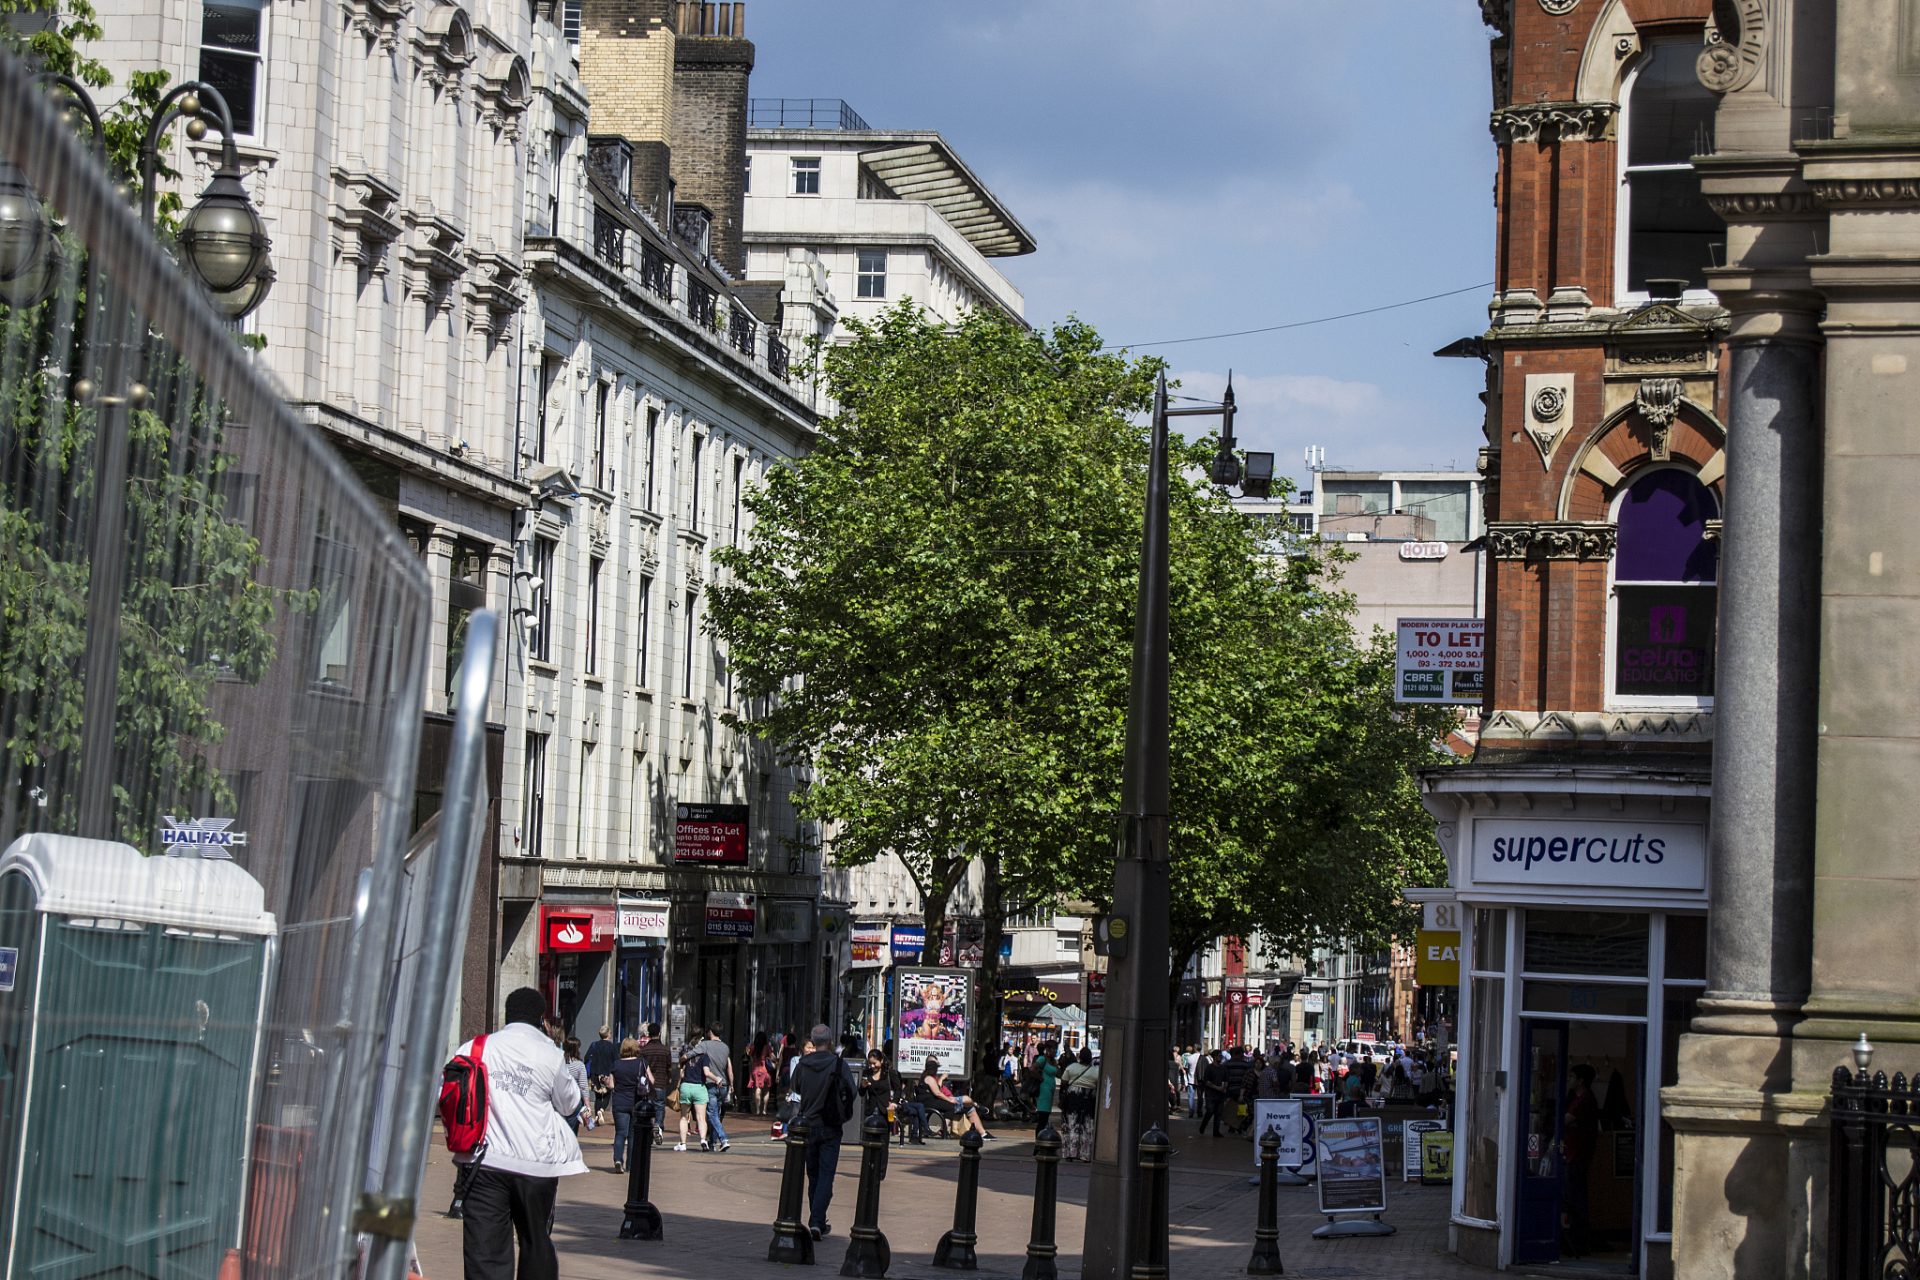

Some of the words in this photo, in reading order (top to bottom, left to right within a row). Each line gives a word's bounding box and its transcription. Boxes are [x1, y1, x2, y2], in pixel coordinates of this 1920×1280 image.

[1403, 544, 1446, 556] HOTEL
[1415, 631, 1441, 647] TO
[1448, 632, 1484, 648] LET
[1406, 650, 1429, 659] 1,000
[1438, 650, 1463, 659] 4,000
[1418, 660, 1430, 668] (93
[1455, 660, 1480, 669] SQ.M.)
[1404, 673, 1434, 682] CBRE
[676, 824, 709, 834] Offices
[711, 826, 723, 834] To
[725, 826, 740, 835] Let
[164, 830, 232, 844] HALIFAX
[1492, 833, 1666, 870] supercuts
[624, 914, 665, 930] angels
[1436, 904, 1456, 926] 81
[1428, 946, 1461, 961] EAT
[1570, 988, 1596, 1010] 80
